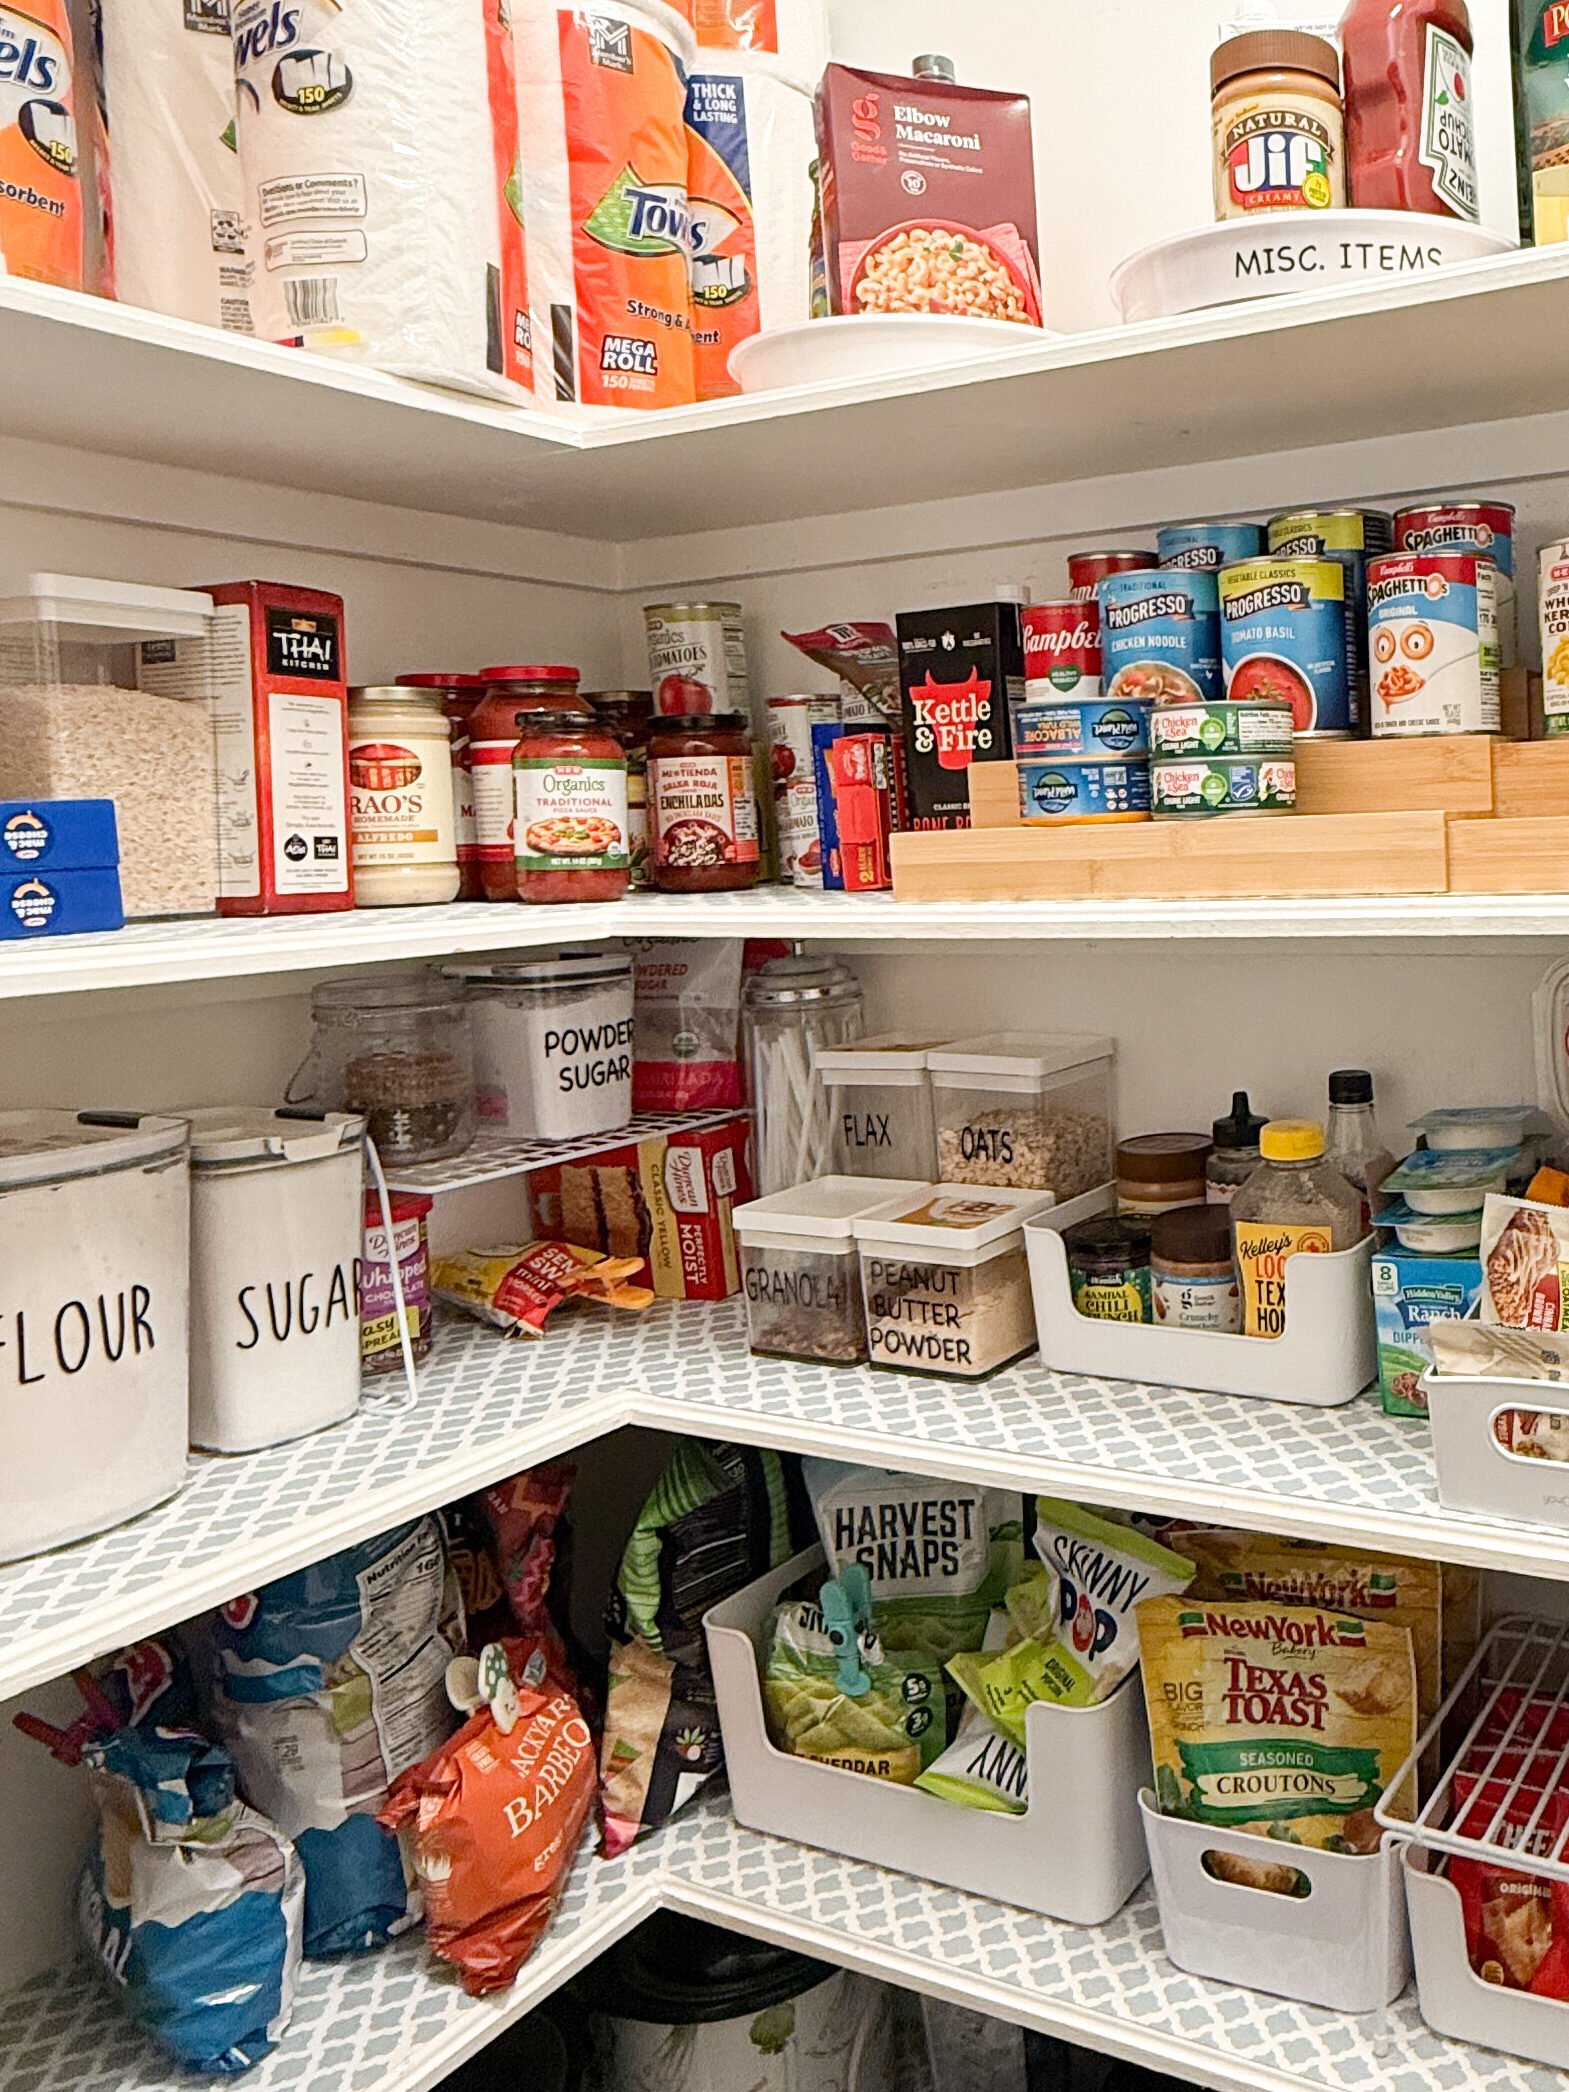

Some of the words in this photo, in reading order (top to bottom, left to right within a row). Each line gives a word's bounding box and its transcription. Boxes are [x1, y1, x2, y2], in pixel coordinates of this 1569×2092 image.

[298, 86, 325, 104] 150
[691, 82, 737, 100] THICK
[693, 99, 702, 110] &
[705, 99, 737, 111] LONG
[693, 111, 738, 124] LASTING
[893, 105, 951, 129] Elbow
[1231, 112, 1322, 141] NATURAL
[895, 123, 981, 150] Macaroni
[1233, 133, 1322, 192] Jif
[1249, 191, 1301, 204] CREAMY
[1235, 247, 1325, 278] MISC.
[1340, 243, 1443, 271] ITEMS
[703, 286, 728, 298] 150
[627, 299, 672, 328] Strong
[674, 312, 685, 327] &
[604, 337, 655, 356] MEGA
[694, 329, 720, 344] ent
[602, 352, 657, 375] ROLL
[602, 374, 628, 389] 150
[1259, 569, 1297, 580] CLASSICS
[1120, 581, 1167, 593] TRADITIONAL
[1108, 596, 1187, 629] PROGRESSO
[1225, 584, 1301, 620] PROGRESSO
[1378, 605, 1418, 619] ORIGINAL
[1231, 627, 1263, 644] TOMATO
[1265, 626, 1296, 640] BASIL
[1548, 621, 1569, 635] CO
[272, 631, 332, 662] THAI
[1111, 636, 1146, 651] CHICKEN
[1147, 635, 1188, 649] NOODLE
[281, 658, 330, 671] KITCHEN
[912, 693, 992, 727] Kettle
[1161, 716, 1198, 729] Chicken
[1170, 727, 1187, 737] Sea
[914, 727, 934, 753] &
[938, 724, 993, 751] Fire
[1024, 729, 1081, 742] ALBACORE
[680, 767, 718, 777] TIENDA
[1163, 771, 1200, 783] Chicken
[543, 773, 606, 797] Organics
[1172, 781, 1189, 792] Sea
[351, 794, 423, 814] RAO'S
[536, 797, 613, 807] TRADITIONAL
[660, 794, 725, 811] ENCHILADAS
[933, 803, 963, 811] CLASSIC
[356, 832, 414, 842] ALFREDO
[544, 1018, 635, 1057] POWDER
[559, 1054, 631, 1092] SUGAR
[843, 1113, 892, 1147] FLAX
[960, 1126, 1014, 1165] OATS
[678, 1150, 699, 1207] Duncan
[650, 1163, 665, 1216] CLASSIC
[656, 1219, 673, 1269] YELLOW
[679, 1223, 700, 1285] MOIST
[693, 1224, 708, 1284] PERFECTLY
[1240, 1231, 1293, 1260] Kelley's
[870, 1260, 961, 1296] PEANUT
[1380, 1265, 1392, 1281] 8
[745, 1267, 841, 1311] GRANOLA
[1405, 1289, 1436, 1299] Hidden
[1435, 1289, 1460, 1302] Valley
[874, 1296, 961, 1330] BUTTER
[1086, 1300, 1129, 1312] CHILI
[1407, 1305, 1461, 1322] Ranch
[1179, 1312, 1219, 1323] Crunchy
[870, 1327, 973, 1366] POWDER
[1393, 1331, 1423, 1344] DIPP
[835, 1498, 976, 1552] HARVEST
[856, 1540, 960, 1582] SNAPS
[1053, 1534, 1152, 1614] SKINNY
[1272, 1641, 1317, 1662] Bakery
[1223, 1657, 1328, 1700] TEXAS
[1163, 1681, 1203, 1702] BIG
[1222, 1693, 1330, 1731] TOAST
[511, 1693, 571, 1779] ACKYAR
[1239, 1752, 1314, 1767] SEASONED
[1216, 1773, 1336, 1796] CROUTONS
[1500, 1882, 1551, 1898] ORIGIN
